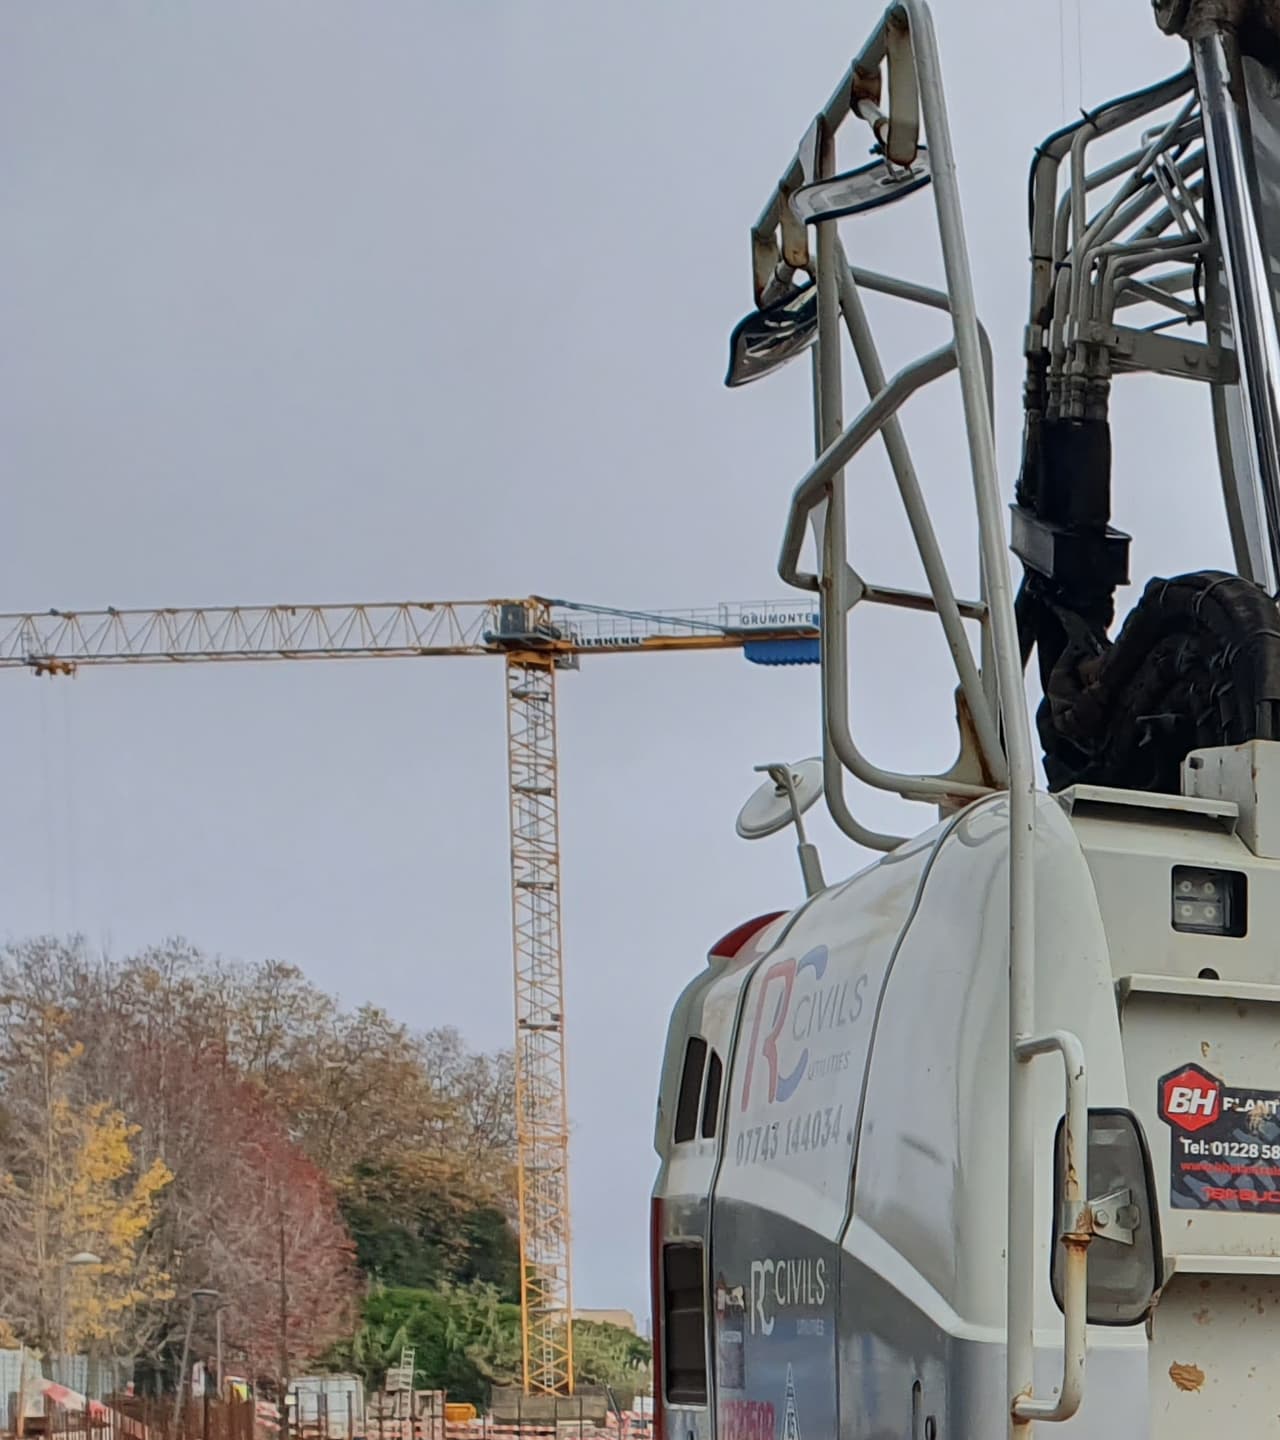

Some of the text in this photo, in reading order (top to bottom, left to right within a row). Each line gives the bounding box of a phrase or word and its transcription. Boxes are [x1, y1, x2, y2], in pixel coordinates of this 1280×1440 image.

[741, 944, 868, 1113] RC CIVILS
[808, 1052, 850, 1080] UTILITIES
[1168, 1086, 1217, 1115] BH
[736, 1104, 843, 1166] 07743 144034
[1182, 1139, 1209, 1155] Tel:
[1212, 1140, 1259, 1158] 01228
[751, 1257, 826, 1336] RC CIVILS
